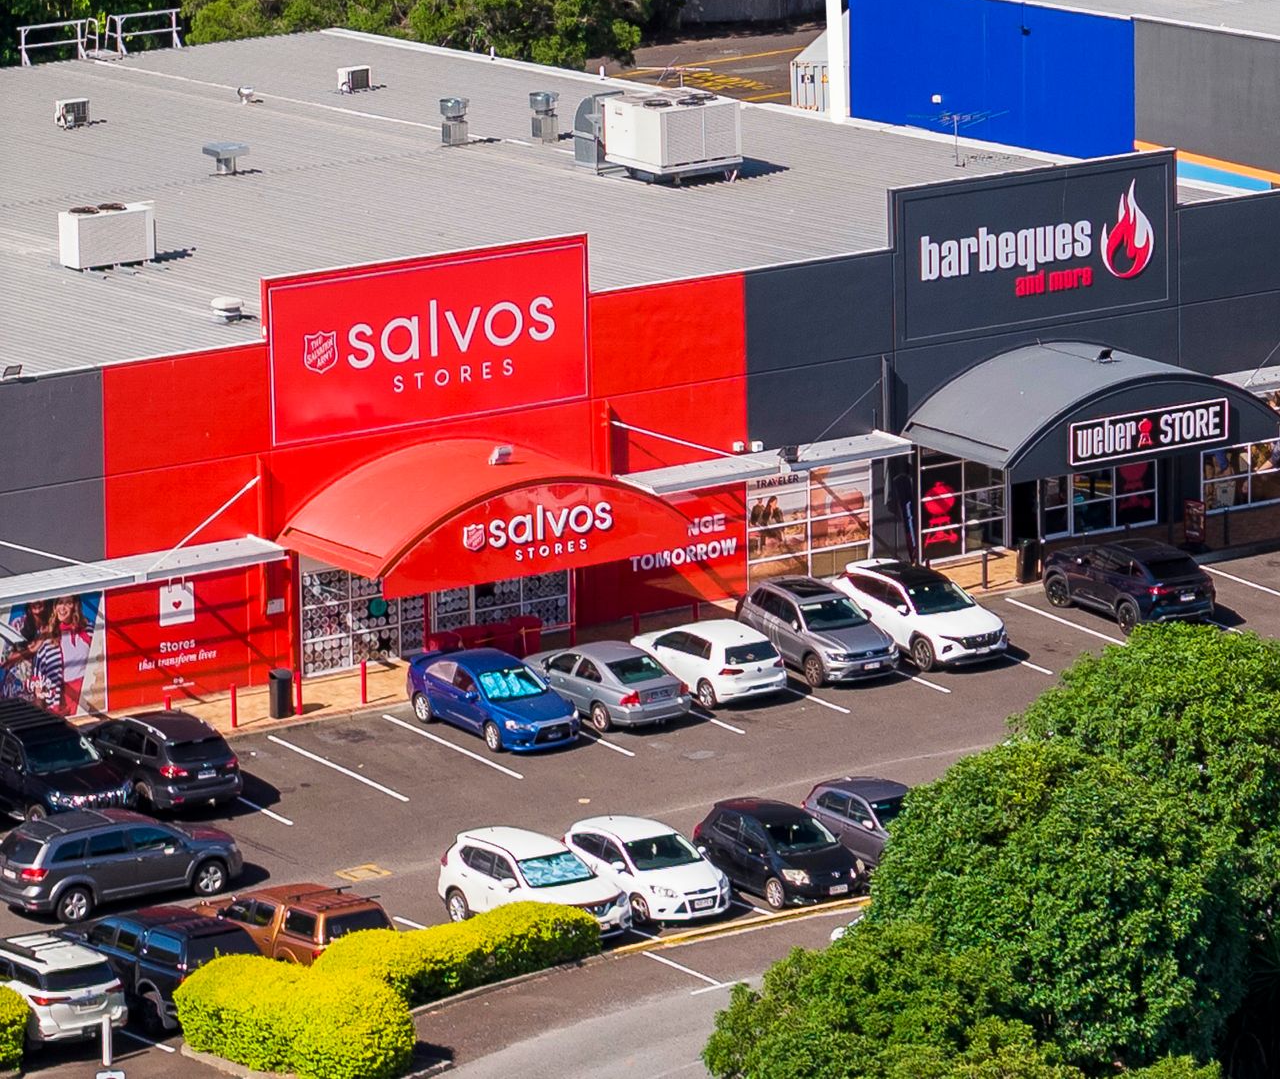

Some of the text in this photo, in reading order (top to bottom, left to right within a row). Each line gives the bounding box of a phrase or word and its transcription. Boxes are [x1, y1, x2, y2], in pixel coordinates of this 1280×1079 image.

[920, 220, 1093, 282] barbeques
[1015, 266, 1093, 297] and more
[347, 296, 556, 370] salvos
[393, 358, 514, 393] STORES
[1075, 405, 1221, 459] weber STORE
[755, 474, 800, 490] TRAVELER
[488, 501, 614, 549] salvos
[514, 538, 588, 562] STORES
[630, 537, 738, 572] TOMORROW
[159, 639, 196, 654] Stores
